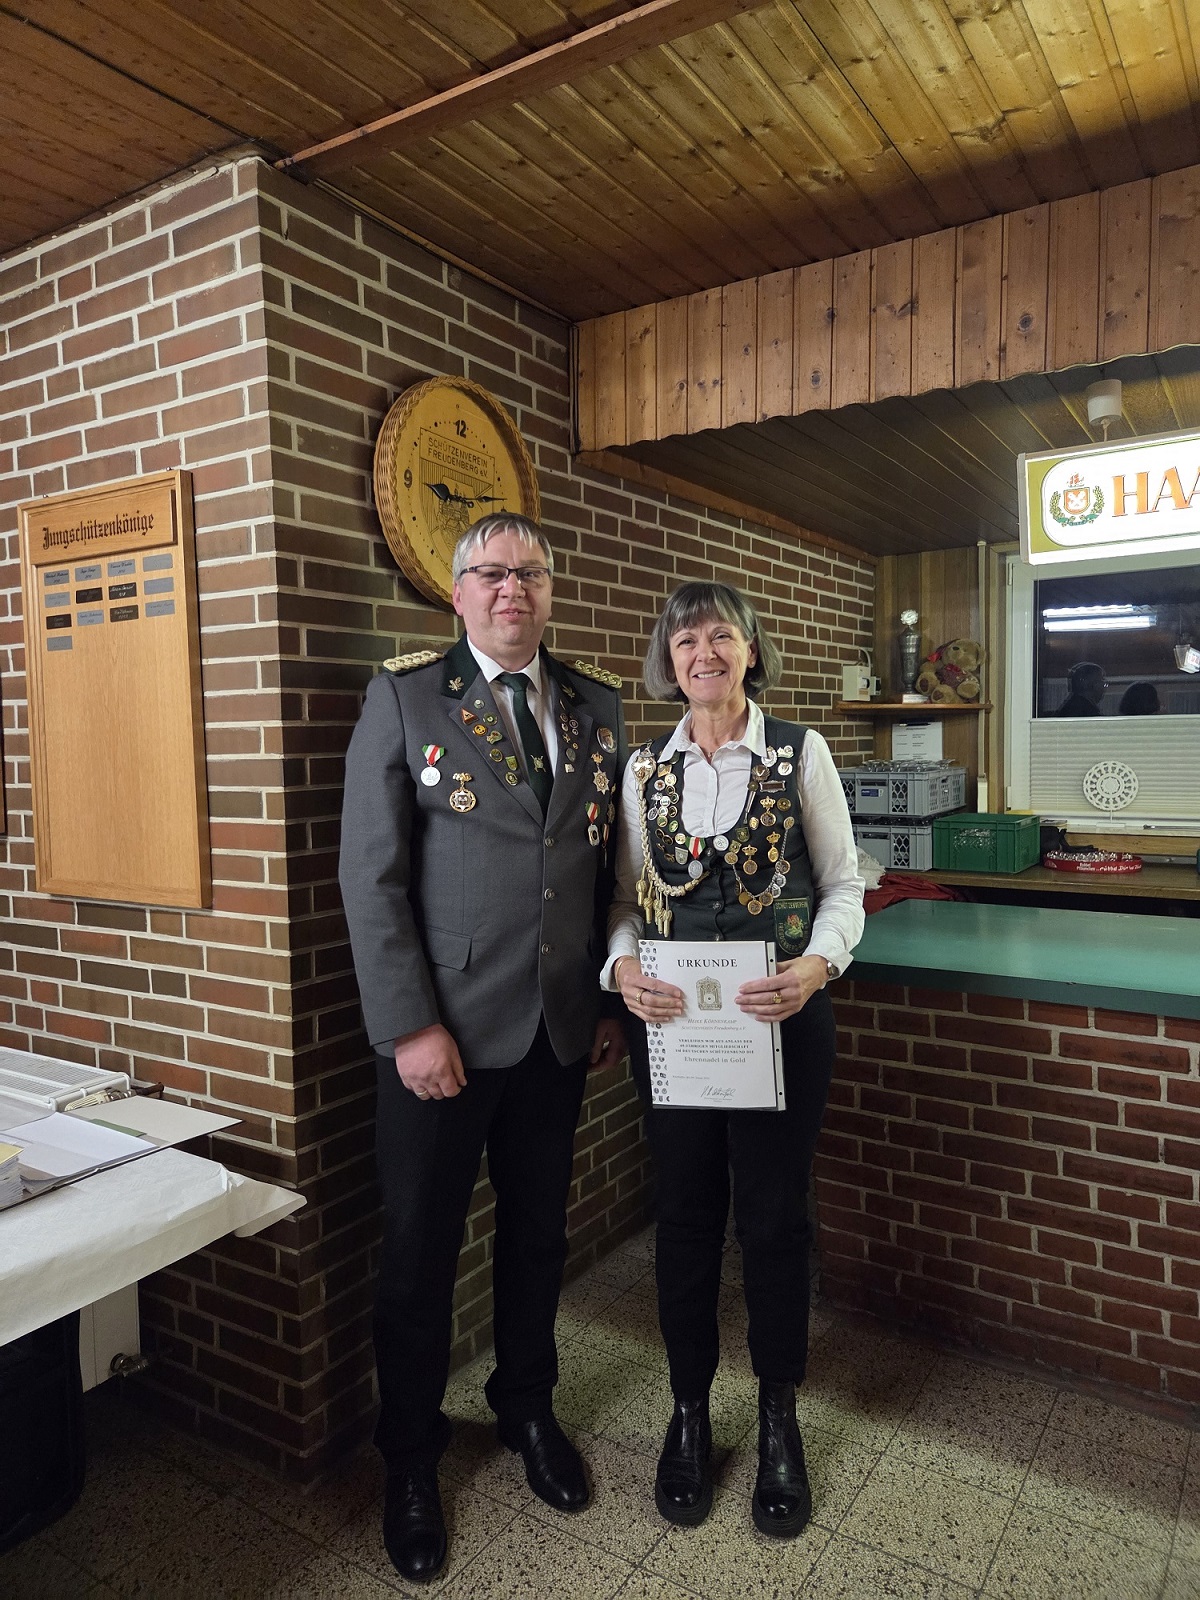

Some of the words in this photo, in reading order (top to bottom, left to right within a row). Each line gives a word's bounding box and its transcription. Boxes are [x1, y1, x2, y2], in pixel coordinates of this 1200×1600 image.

[455, 419, 467, 438] 12
[427, 436, 488, 469] SCHÜTZENVEREIN
[427, 447, 479, 475] FREUDENBERG
[403, 469, 413, 489] 9
[42, 509, 154, 550] Jungschützenkönige
[677, 958, 738, 968] URKUNDE
